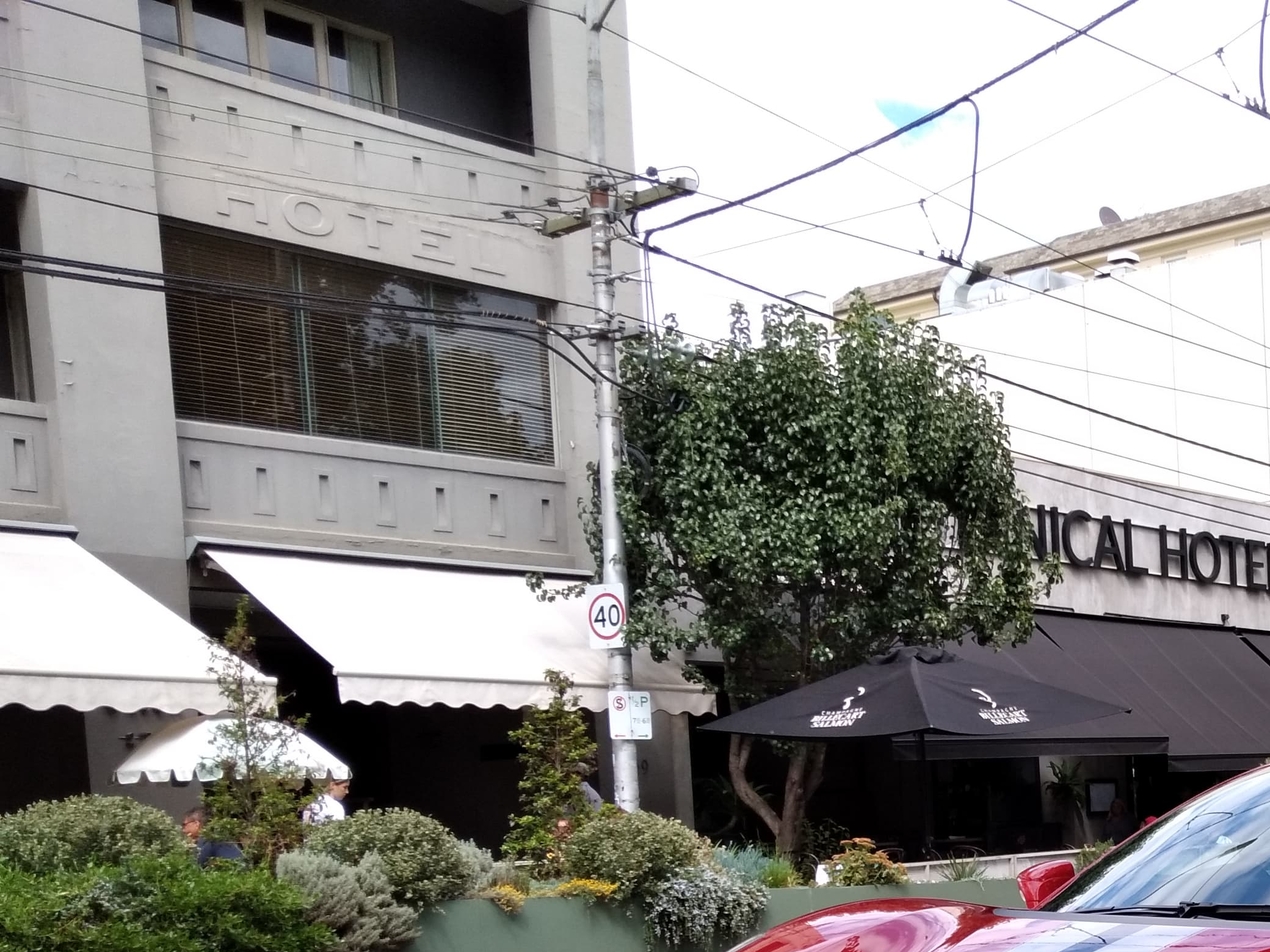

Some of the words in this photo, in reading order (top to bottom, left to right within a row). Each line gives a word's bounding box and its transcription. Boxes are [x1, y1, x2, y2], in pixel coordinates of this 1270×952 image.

[217, 178, 505, 277] HOTEL
[594, 604, 620, 628] 40
[810, 719, 857, 728] SALMON
